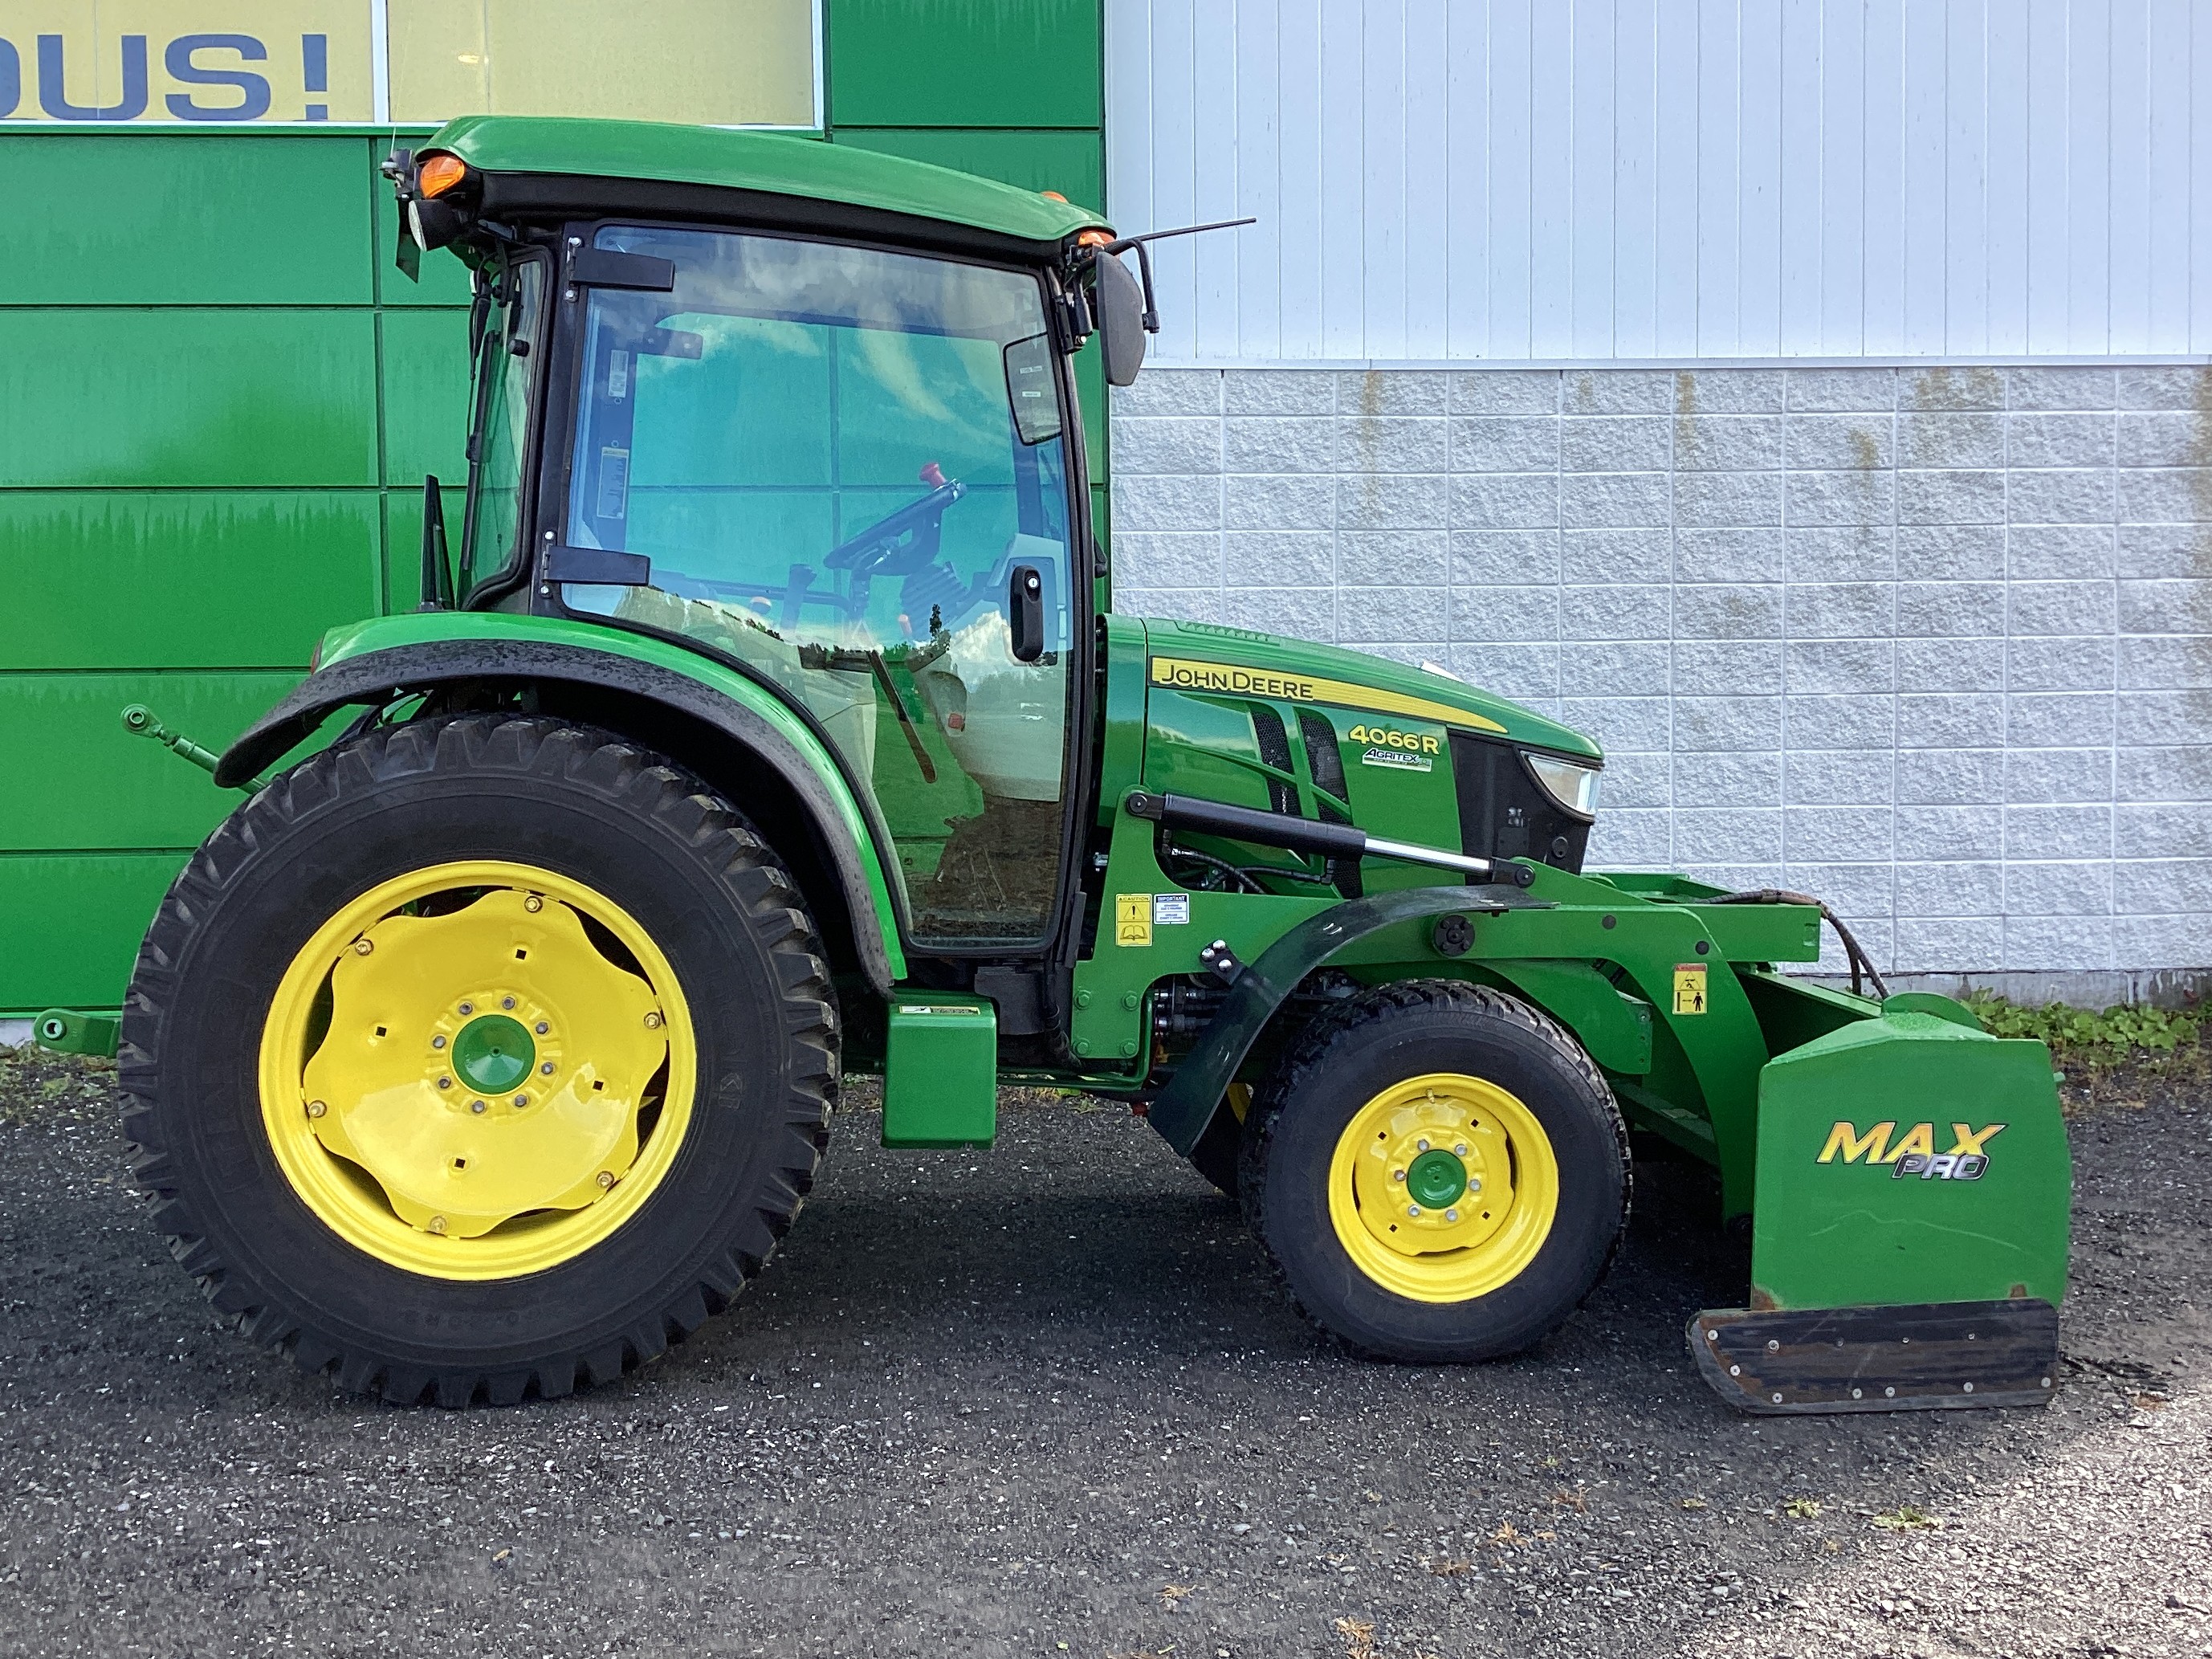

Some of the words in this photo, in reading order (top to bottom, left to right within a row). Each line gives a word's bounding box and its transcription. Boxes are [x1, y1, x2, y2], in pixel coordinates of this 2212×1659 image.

[0, 35, 328, 120] US!
[1161, 664, 1228, 689] JOHN
[1232, 671, 1314, 699] DEERE
[1349, 724, 1440, 755] 4066R
[1365, 748, 1420, 763] AGRITEX
[1816, 1121, 2007, 1164] MAX
[1891, 1153, 1990, 1180] PRO
